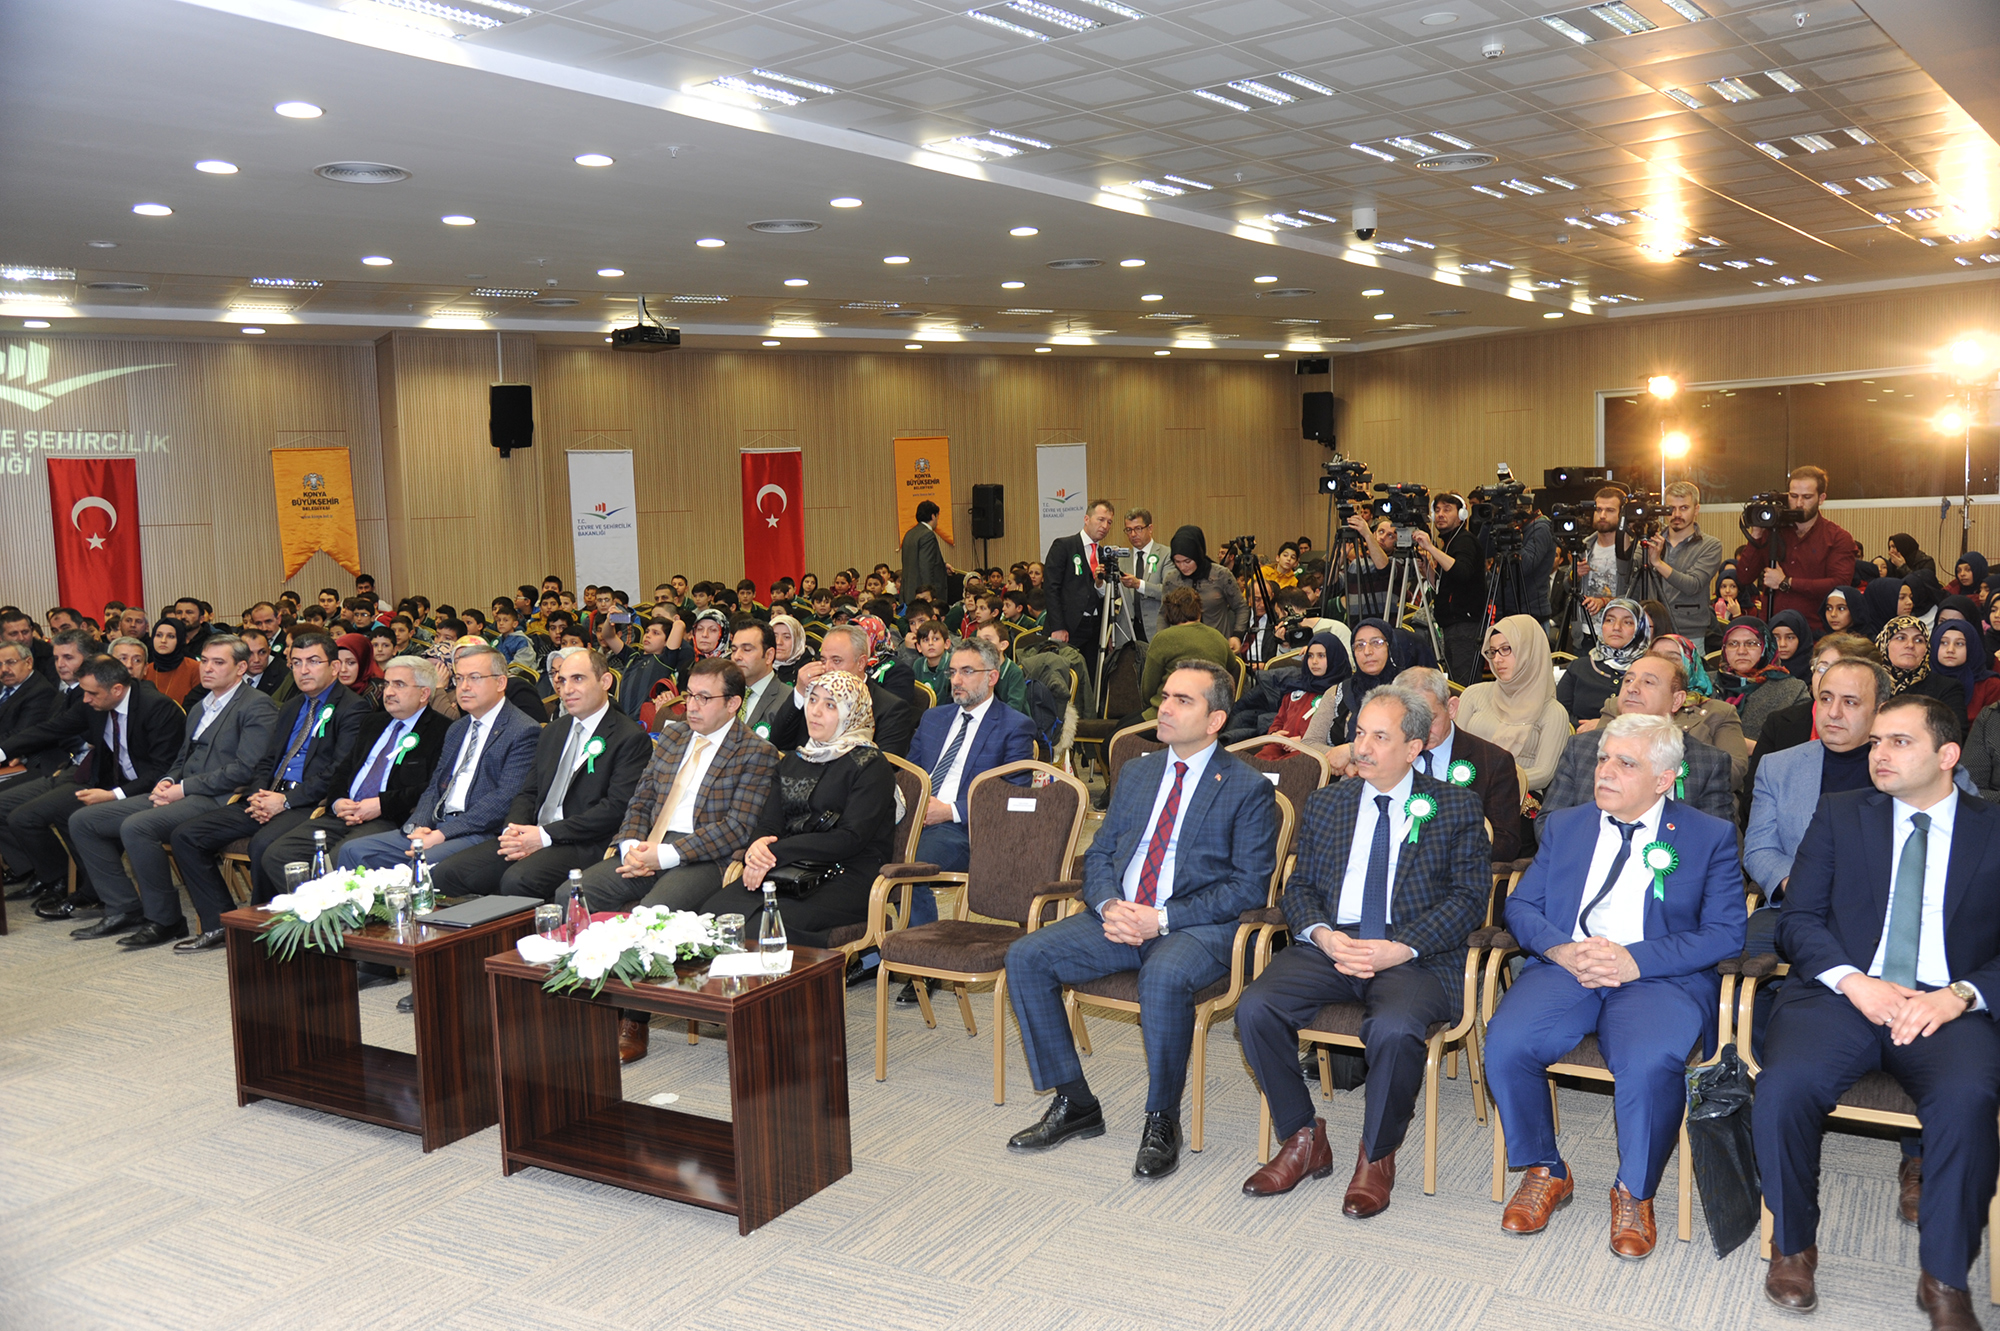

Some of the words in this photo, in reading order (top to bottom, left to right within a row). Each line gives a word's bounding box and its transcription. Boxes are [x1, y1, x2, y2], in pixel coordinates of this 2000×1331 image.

[0, 430, 17, 449] E
[23, 428, 170, 454] ŞEHİRCİLİK
[291, 497, 339, 506] BÜYÜKŞEHİR
